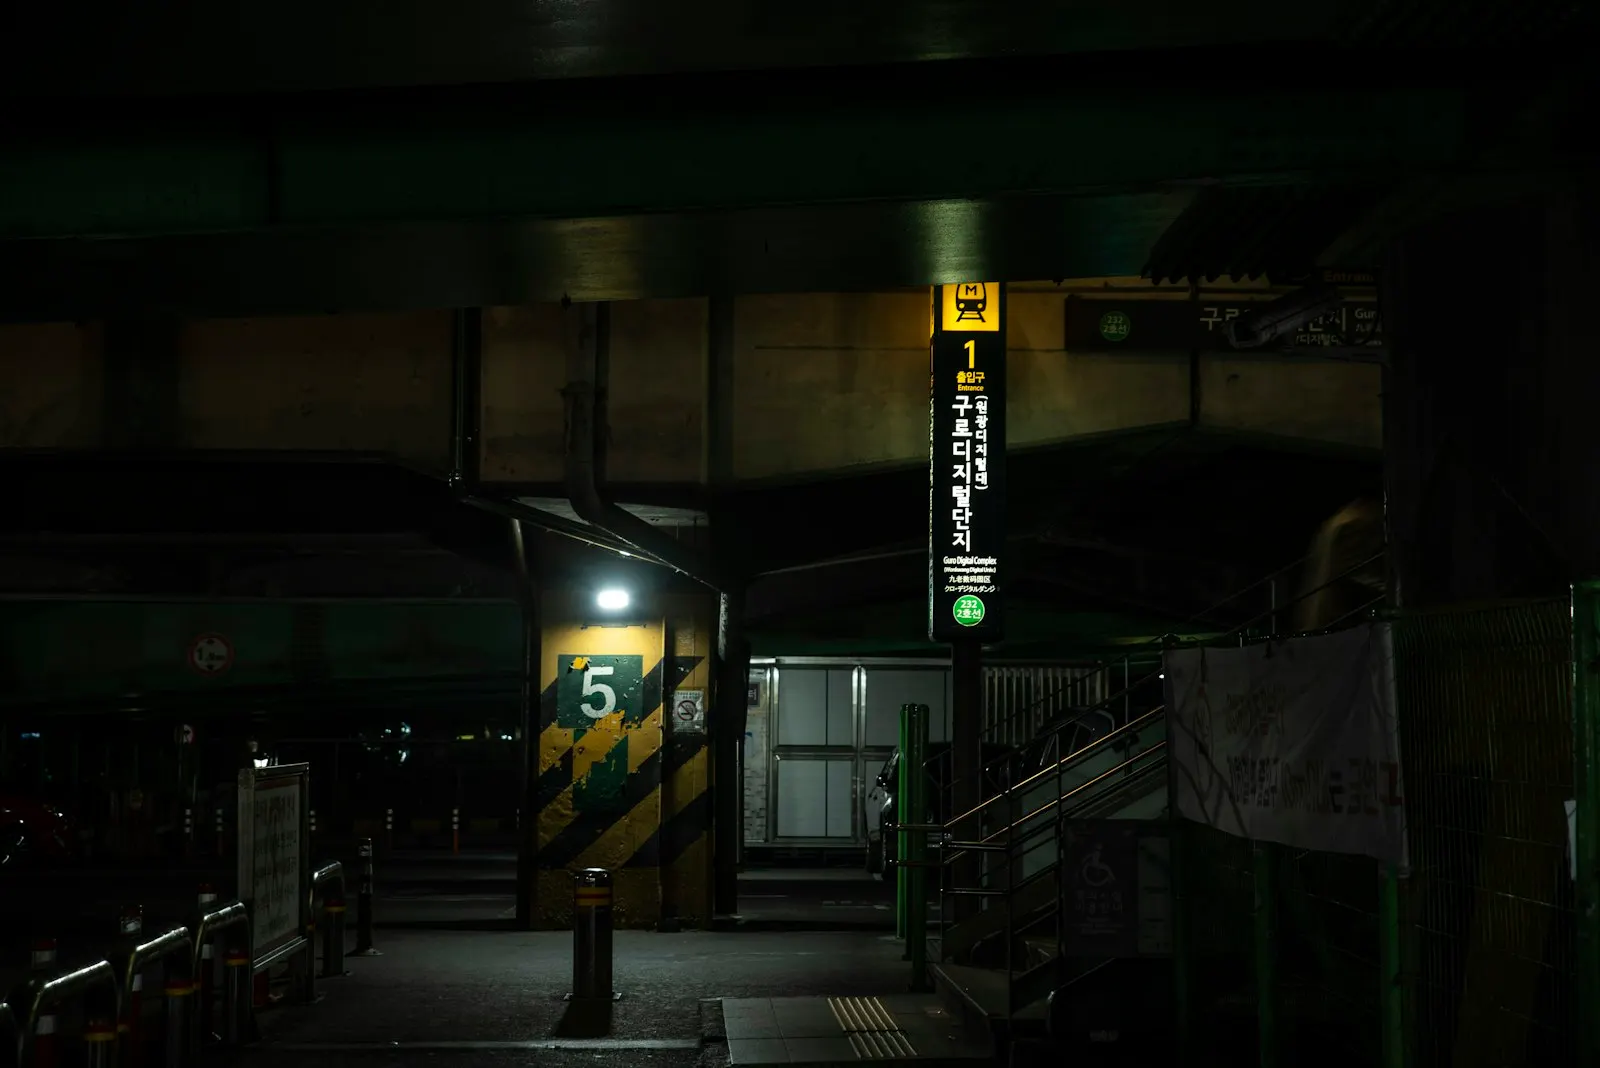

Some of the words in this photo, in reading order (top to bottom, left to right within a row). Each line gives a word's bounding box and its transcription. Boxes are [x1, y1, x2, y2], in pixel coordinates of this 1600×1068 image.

[1355, 307, 1377, 319] Gur
[964, 339, 975, 369] 1
[956, 370, 985, 383] 출입구
[957, 384, 985, 392] Entrance
[974, 395, 989, 490] (원광디지털대)
[951, 395, 973, 553] 구로디지털단지
[943, 555, 957, 564] Guro
[957, 555, 973, 566] Digital
[974, 556, 997, 566] Complex
[960, 600, 978, 609] 232
[956, 608, 982, 619] 2호선
[580, 666, 617, 719] 5
